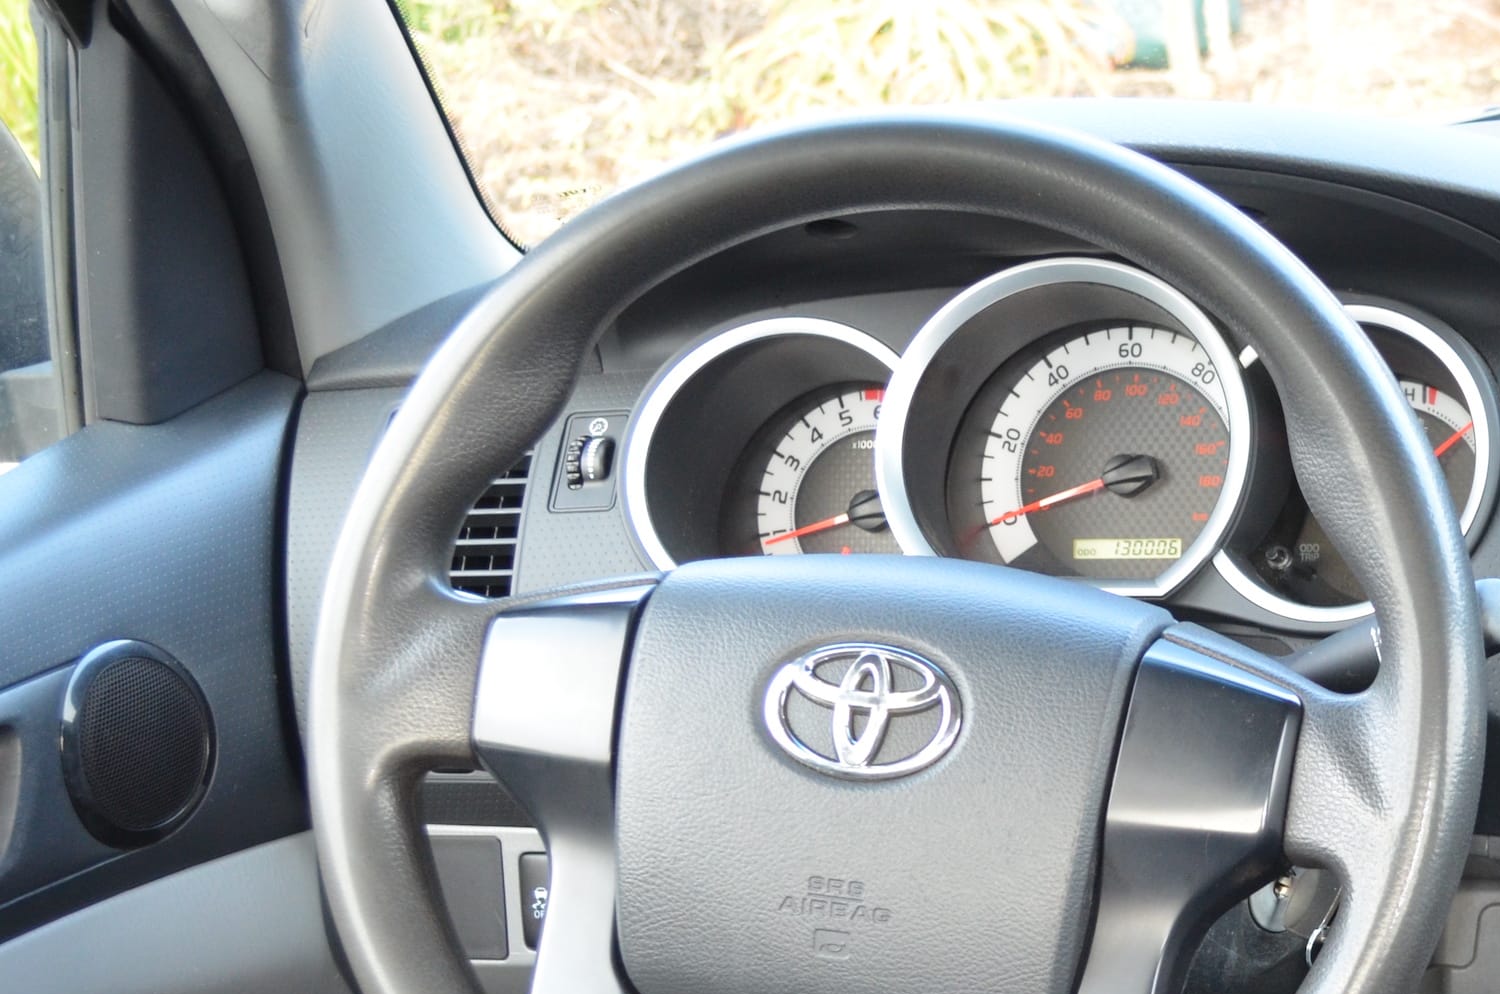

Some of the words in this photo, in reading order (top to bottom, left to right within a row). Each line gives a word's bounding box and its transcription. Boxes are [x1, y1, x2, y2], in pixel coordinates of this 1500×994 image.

[1118, 342, 1143, 359] 60
[1047, 364, 1070, 387] 40
[1191, 361, 1216, 386] 80
[839, 409, 853, 428] 5
[1065, 407, 1083, 420] 60
[810, 426, 824, 444] 4
[1002, 428, 1022, 454] 20
[1045, 432, 1063, 445] 40
[784, 454, 801, 472] 3
[772, 489, 789, 505] 2
[1114, 540, 1178, 556] 130006
[1299, 543, 1320, 553] ODO
[807, 875, 865, 895] SRS
[778, 895, 894, 923] AIRBAG
